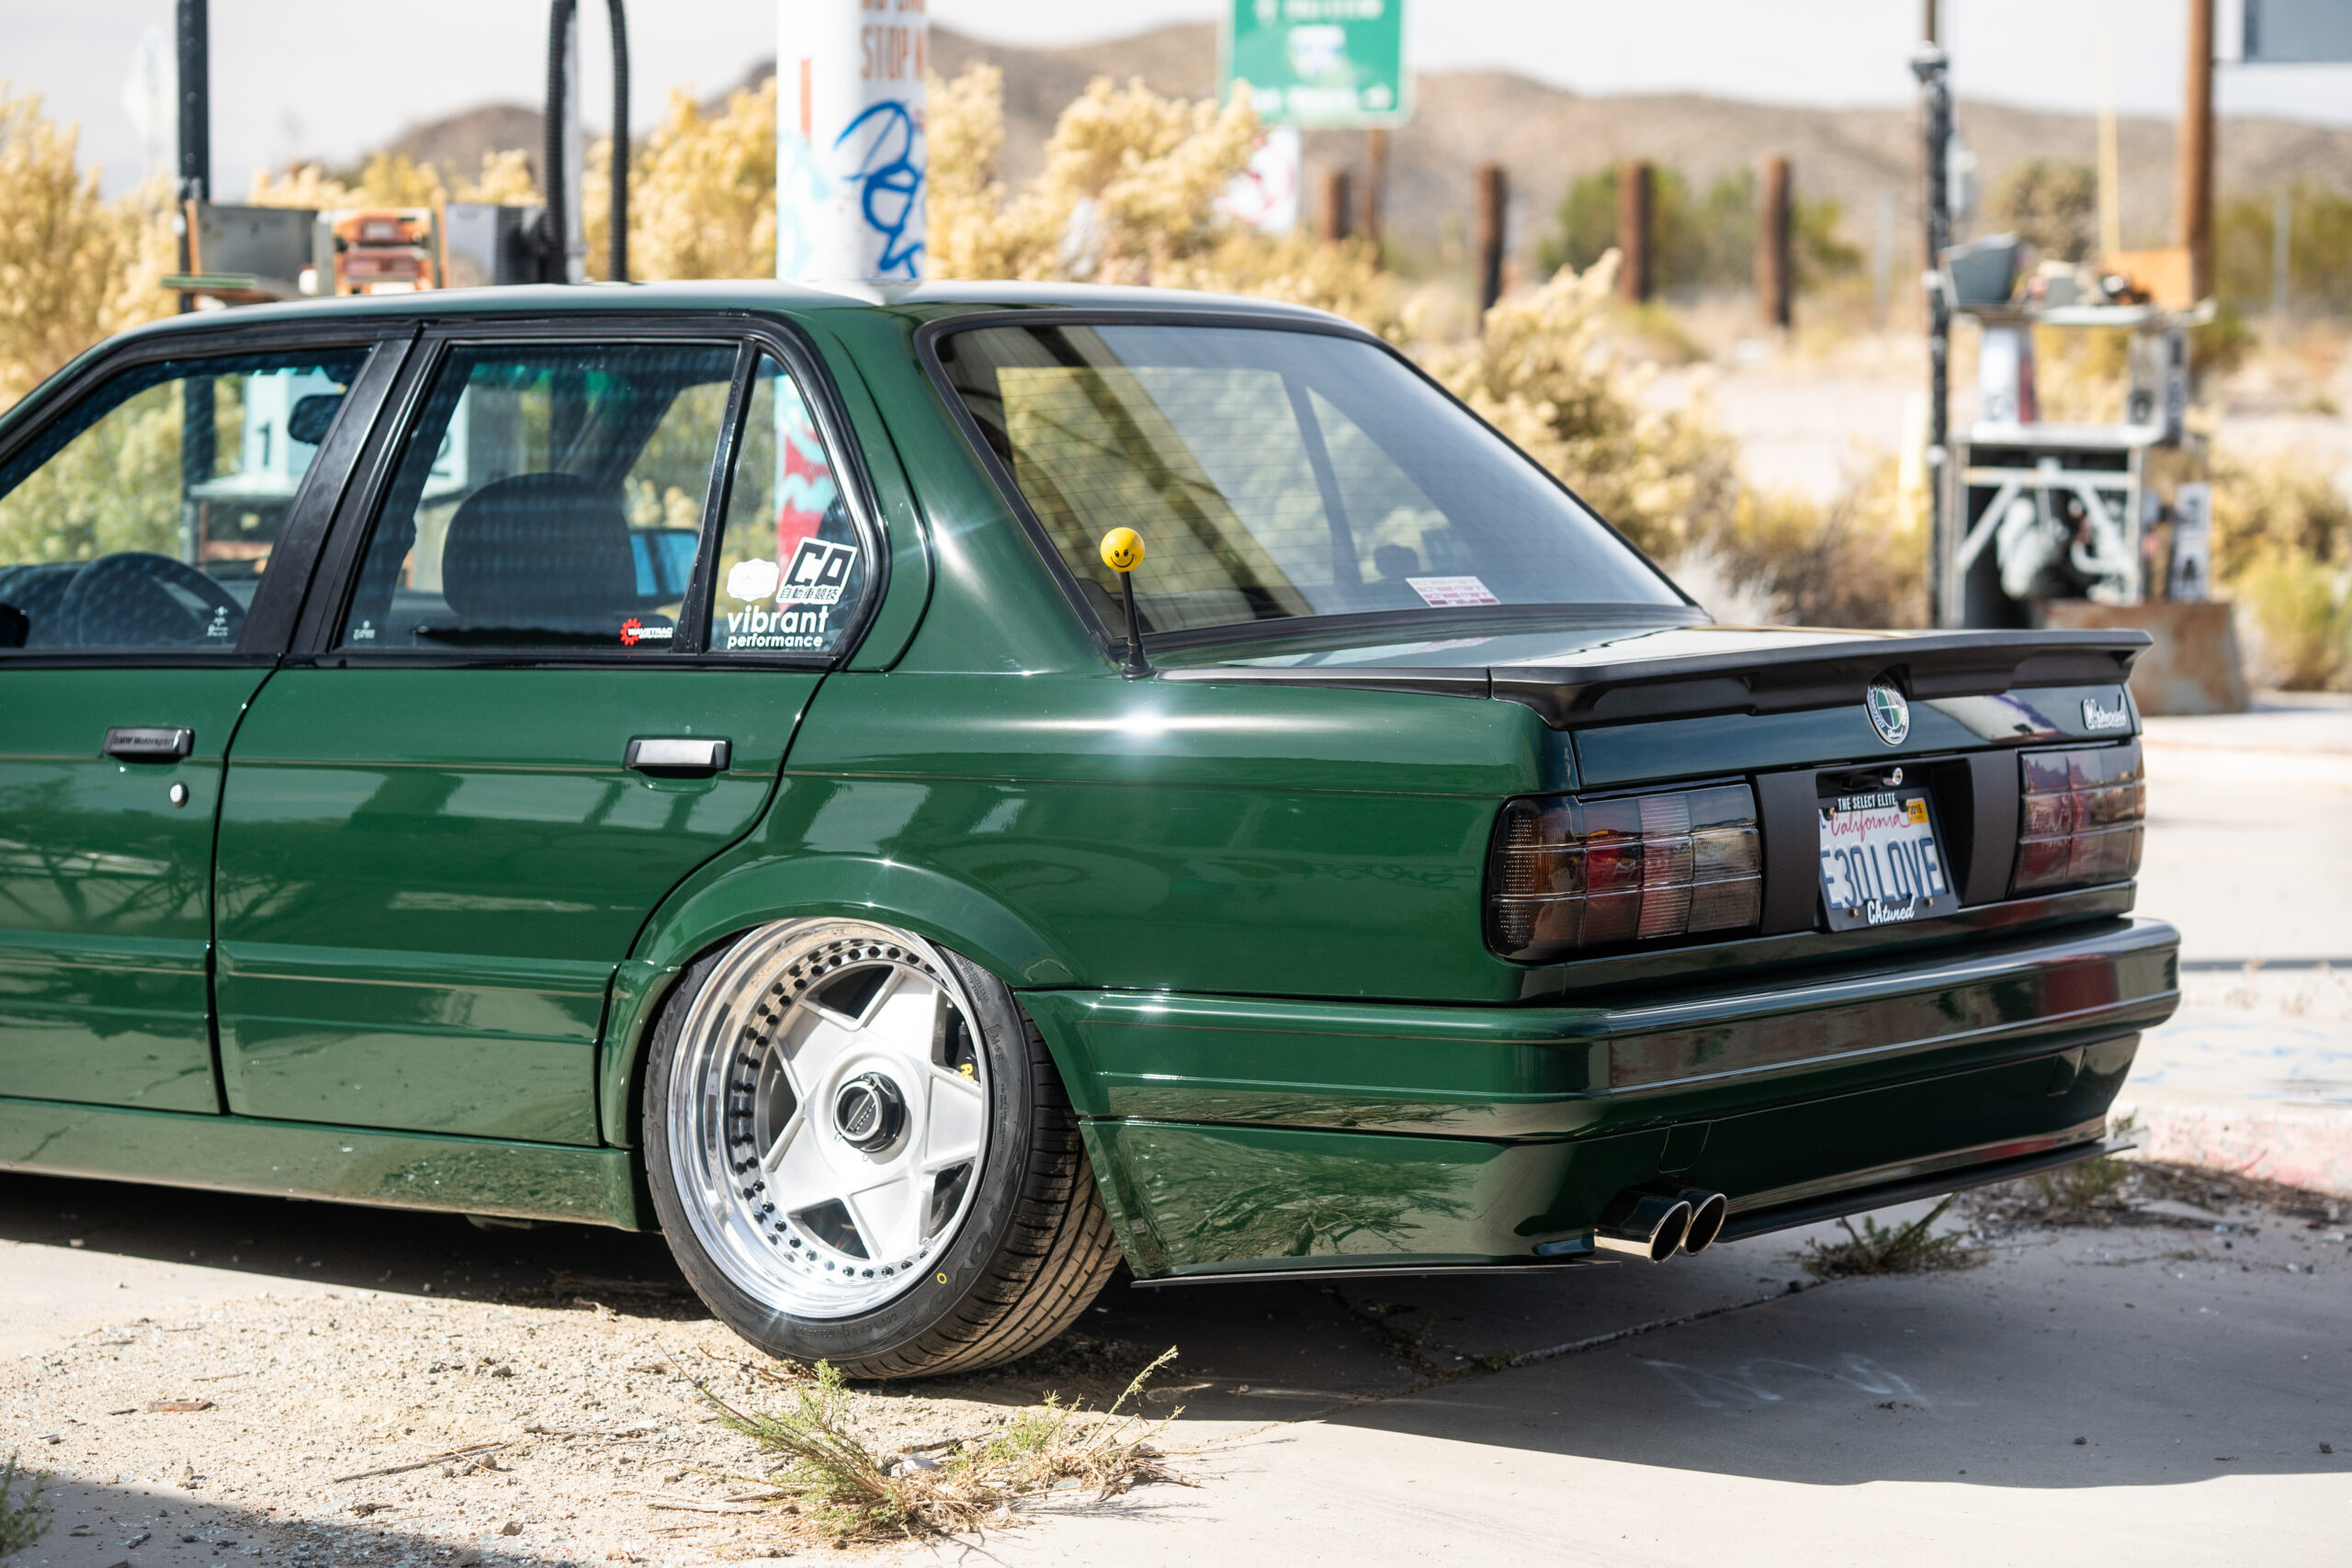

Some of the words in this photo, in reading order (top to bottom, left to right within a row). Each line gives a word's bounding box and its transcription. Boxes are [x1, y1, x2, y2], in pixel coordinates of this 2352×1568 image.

[727, 604, 829, 633] vibrant
[727, 633, 823, 649] performance
[1838, 797, 1851, 811] THE
[1852, 795, 1876, 809] SELECT
[1877, 792, 1897, 807] ELITE
[1830, 810, 1911, 842] California
[1867, 895, 1916, 925] CAtuned
